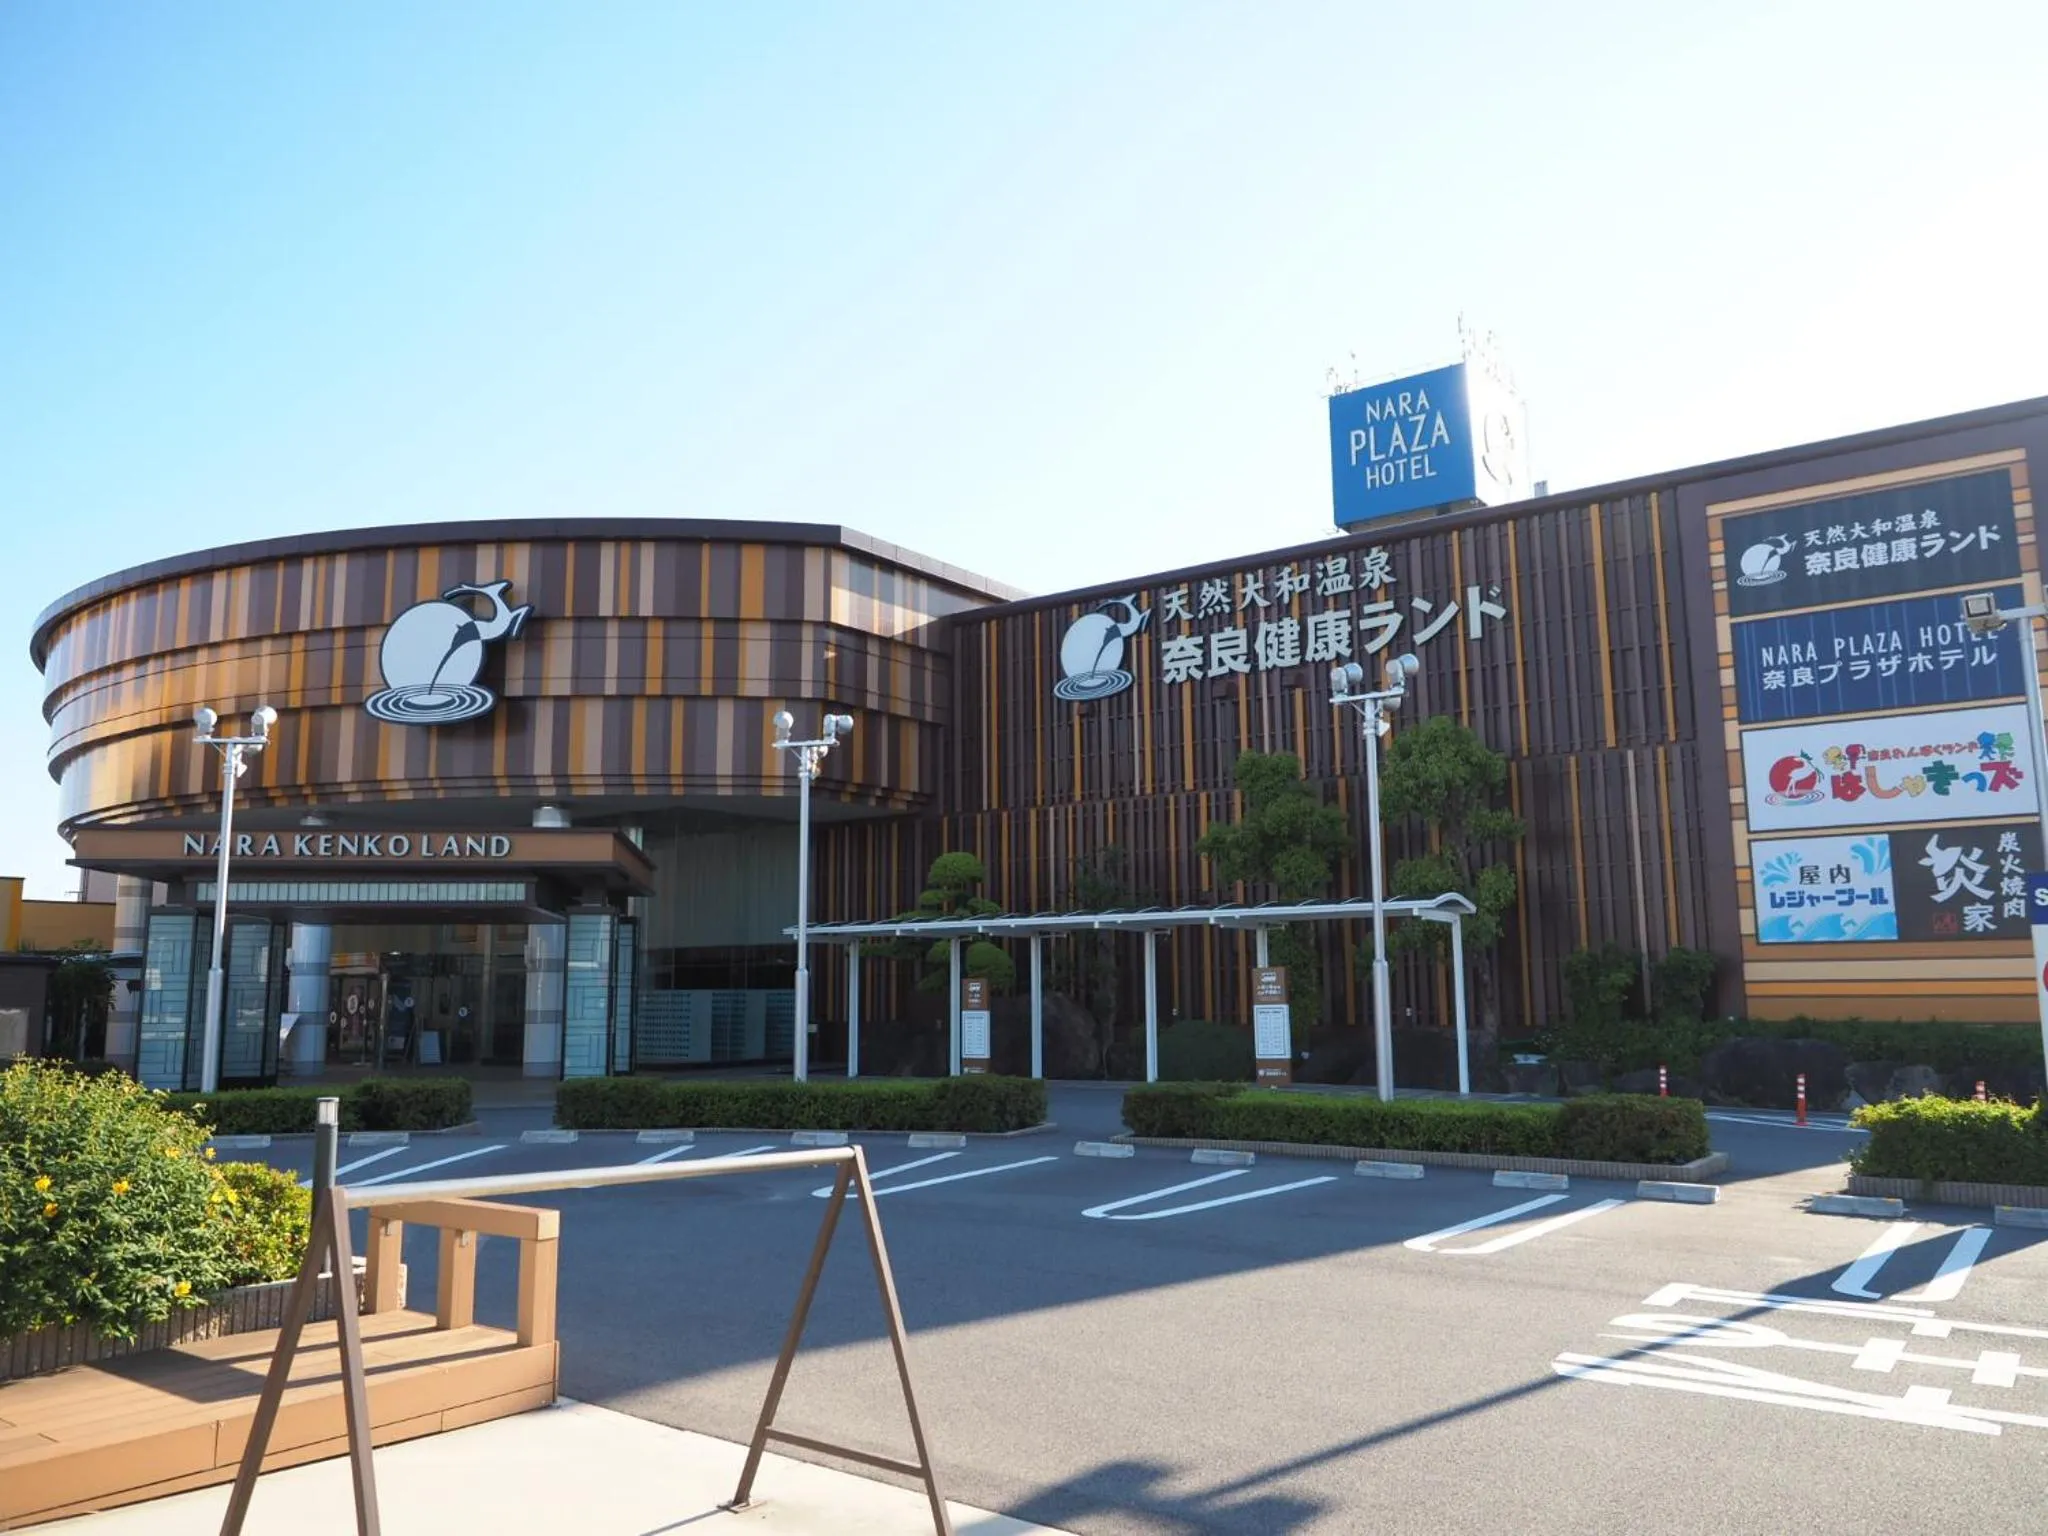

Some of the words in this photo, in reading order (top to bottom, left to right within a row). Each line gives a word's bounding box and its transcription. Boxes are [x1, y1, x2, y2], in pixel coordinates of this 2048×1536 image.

[1366, 388, 1430, 424] NARA
[1350, 411, 1450, 466] PLAZA
[1366, 453, 1437, 490] HOTEL
[1804, 508, 1941, 547] 天然大和温泉
[1804, 523, 2001, 576] 奈良健康ランド
[1162, 546, 1397, 624] 天然大和温泉
[1161, 584, 1508, 684] 奈良健康ランド
[1762, 641, 1818, 667] NARA
[1834, 632, 1903, 658] PLAZA
[1762, 645, 1998, 690] 奈良プラザホテル
[294, 834, 410, 857] KENKO
[421, 834, 511, 857] LAND
[1799, 864, 1852, 885] 屋内
[1997, 831, 2027, 918] 炭火焼肉
